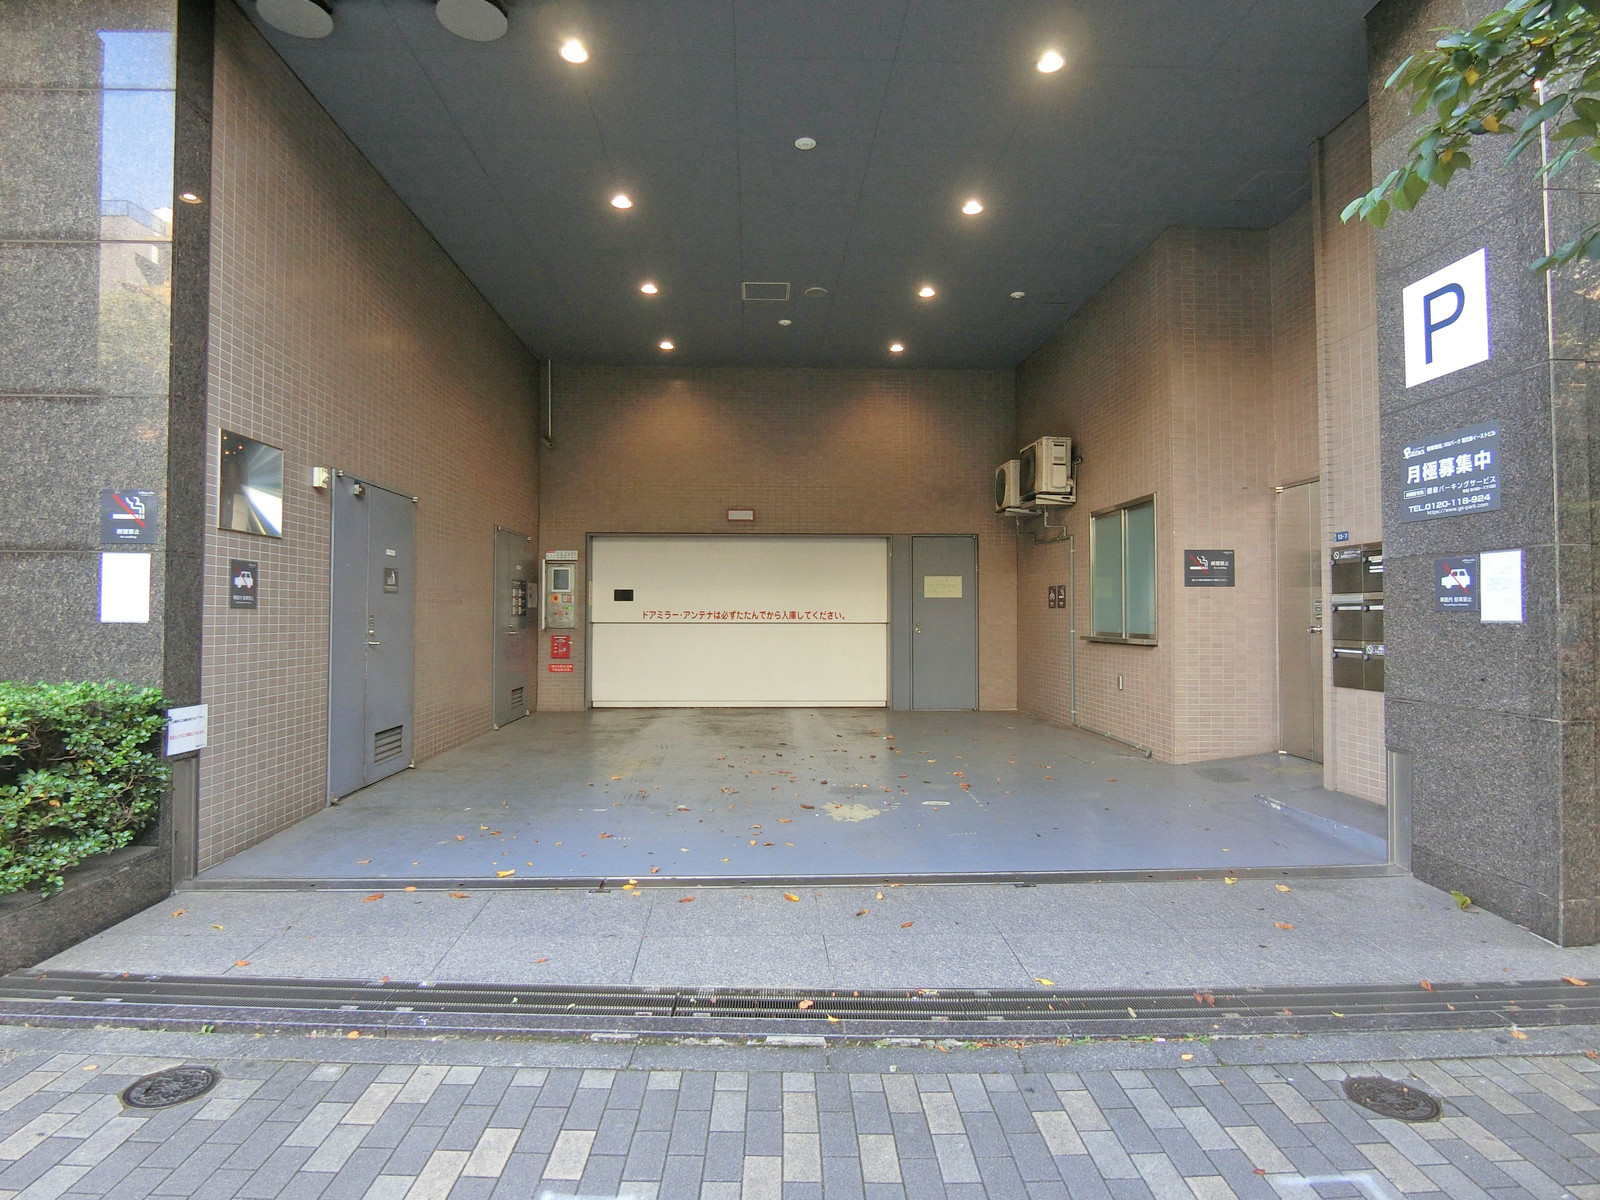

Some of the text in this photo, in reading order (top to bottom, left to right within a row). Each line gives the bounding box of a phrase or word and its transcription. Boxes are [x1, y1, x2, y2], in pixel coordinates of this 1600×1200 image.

[1423, 282, 1465, 365] P
[1406, 449, 1491, 484] 月極募集中
